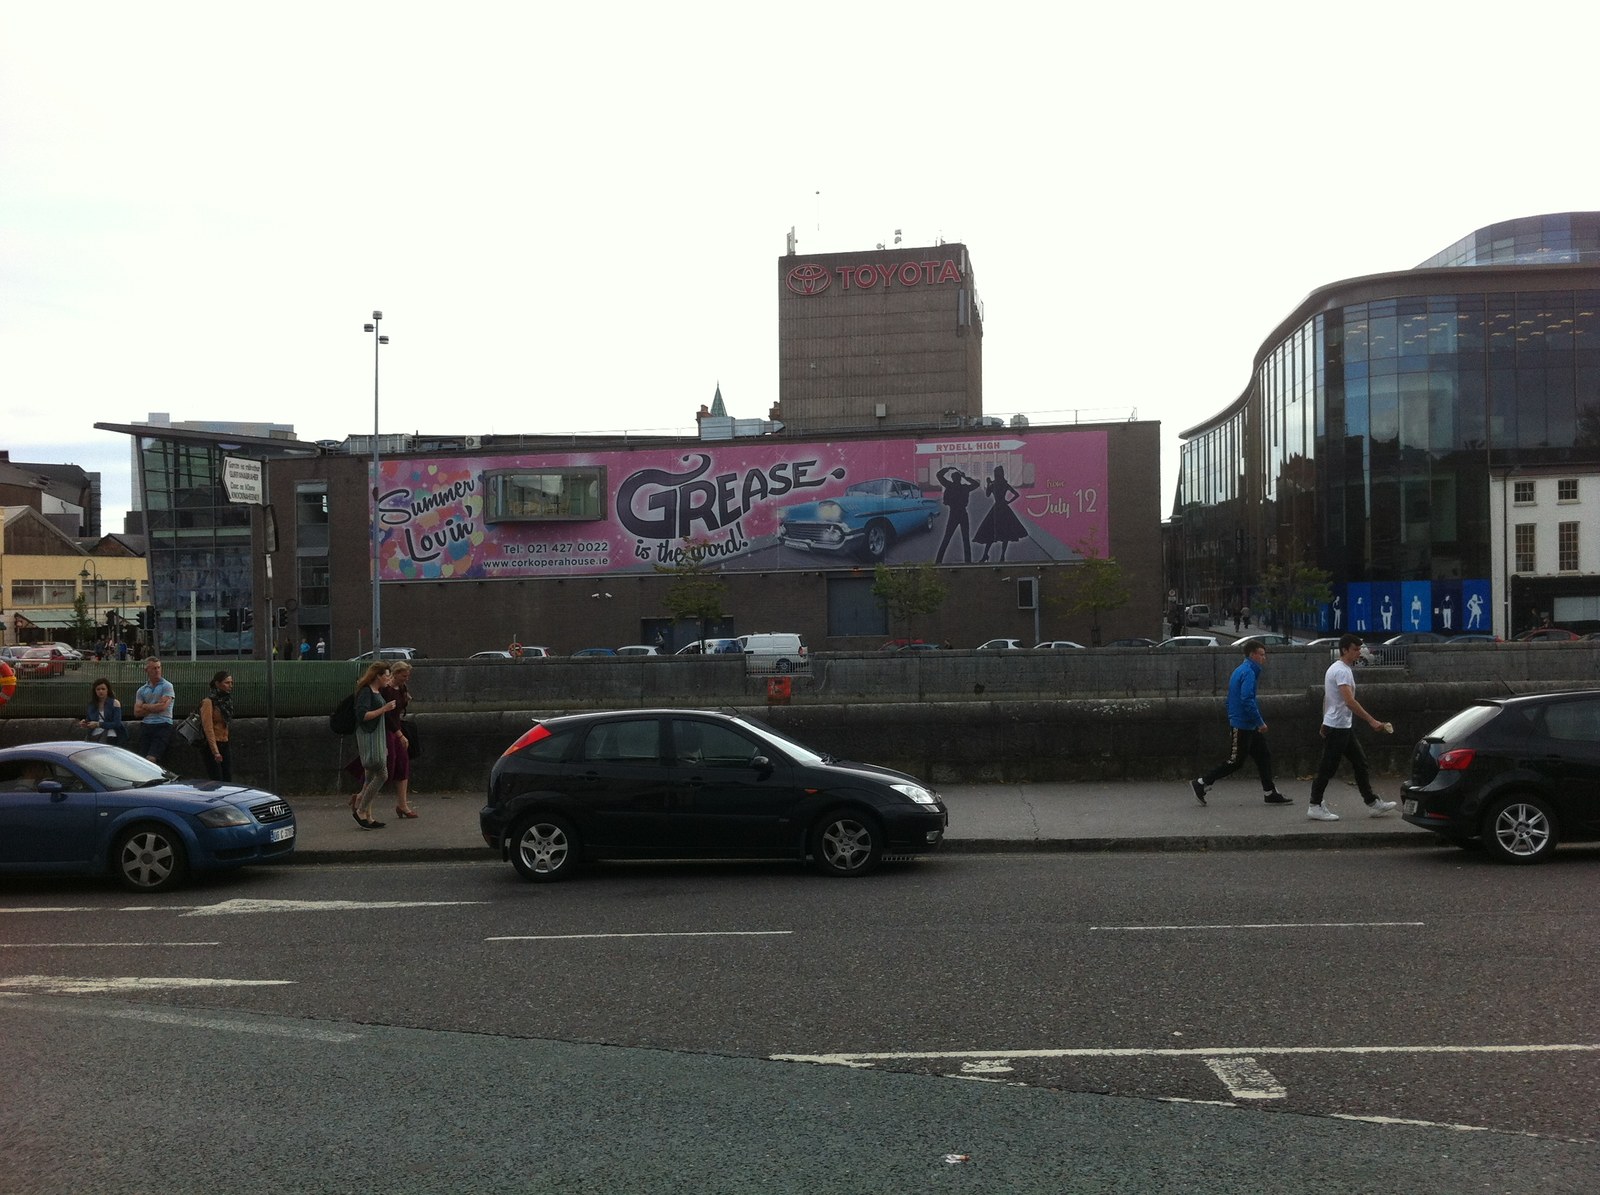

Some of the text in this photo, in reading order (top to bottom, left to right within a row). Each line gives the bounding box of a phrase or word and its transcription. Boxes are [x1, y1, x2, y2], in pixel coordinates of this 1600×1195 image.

[836, 260, 961, 289] TOYOTA
[936, 441, 1000, 452] RYDELL HIGH
[378, 479, 475, 525] Summer
[616, 453, 845, 539] GREASE
[1025, 493, 1070, 519] July
[404, 504, 475, 563] Lovin'
[504, 542, 608, 554] Tel: 021 427 0022
[635, 539, 651, 560] is
[657, 540, 685, 563] the
[483, 557, 608, 568] www.corkoperahouse.ie
